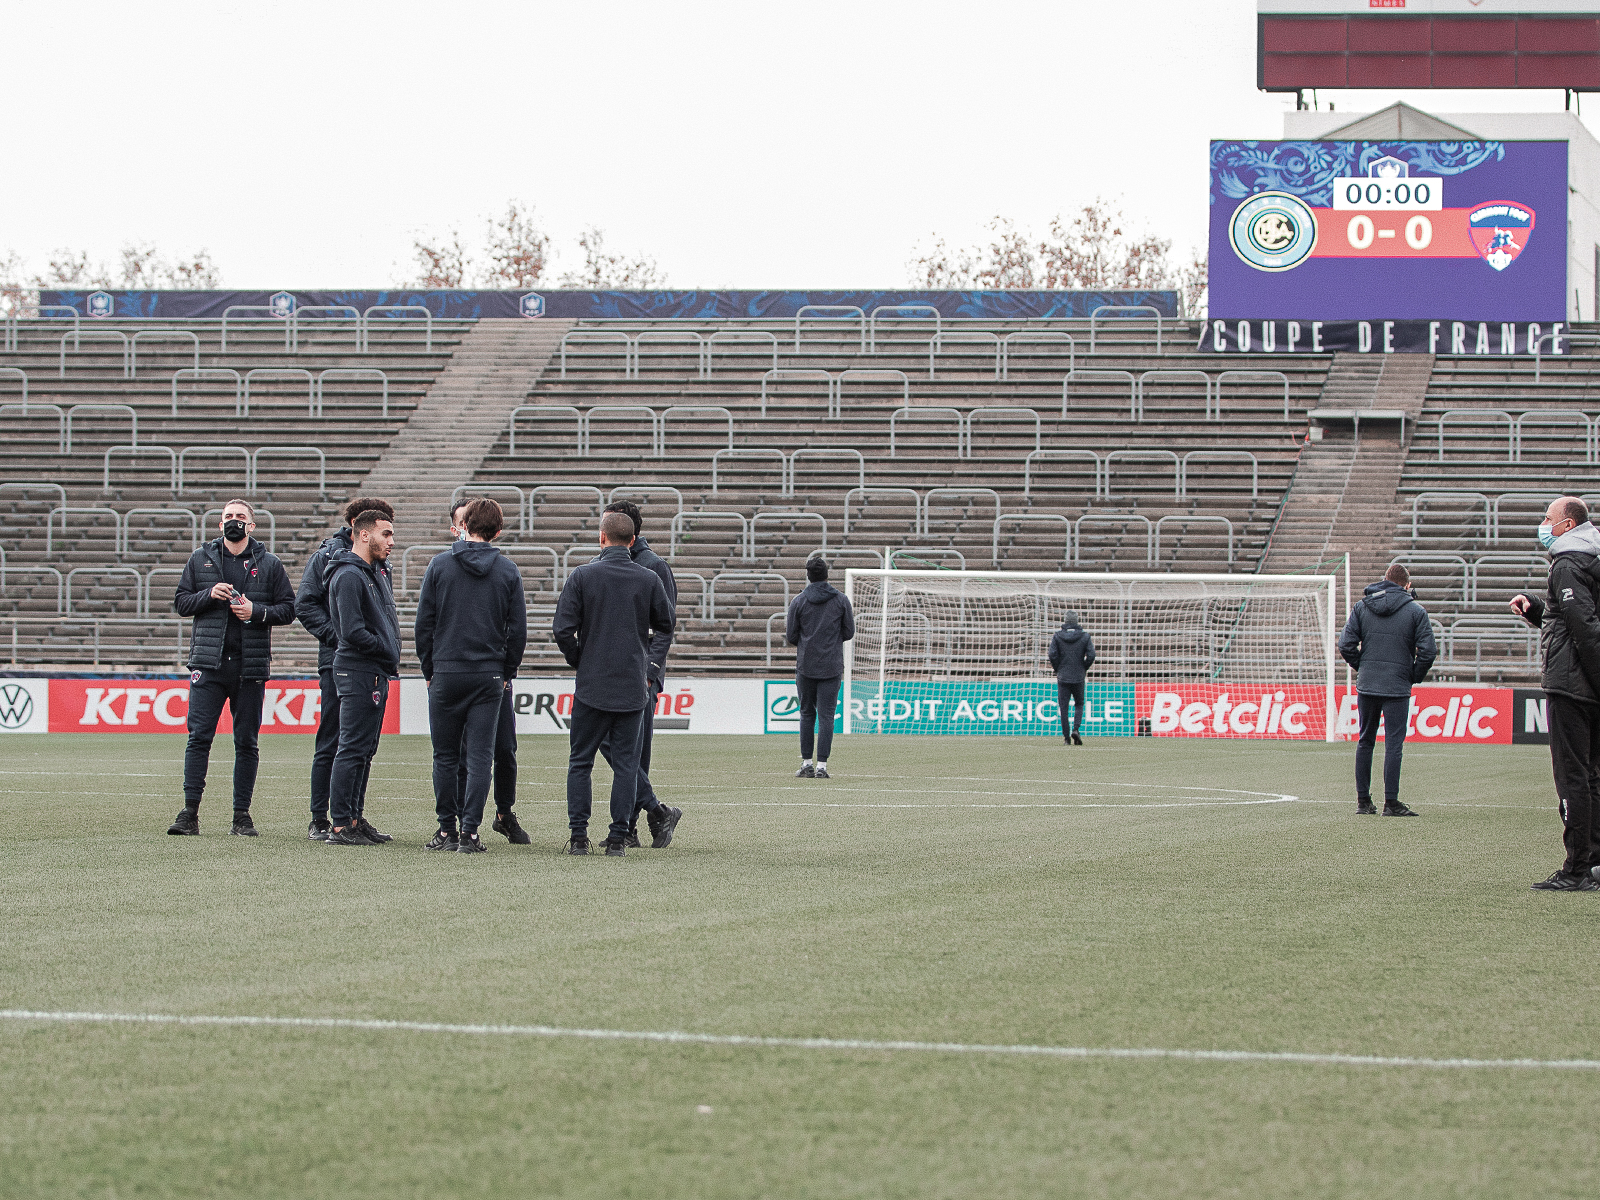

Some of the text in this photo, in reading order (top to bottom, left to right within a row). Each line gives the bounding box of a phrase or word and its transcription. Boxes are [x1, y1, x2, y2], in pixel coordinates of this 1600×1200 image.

[1346, 183, 1430, 204] 00:00
[1213, 320, 1565, 355] COUPE DE FRANCE
[79, 687, 190, 726] KFC
[1150, 690, 1311, 735] Betclic
[1335, 693, 1499, 739] Btclic
